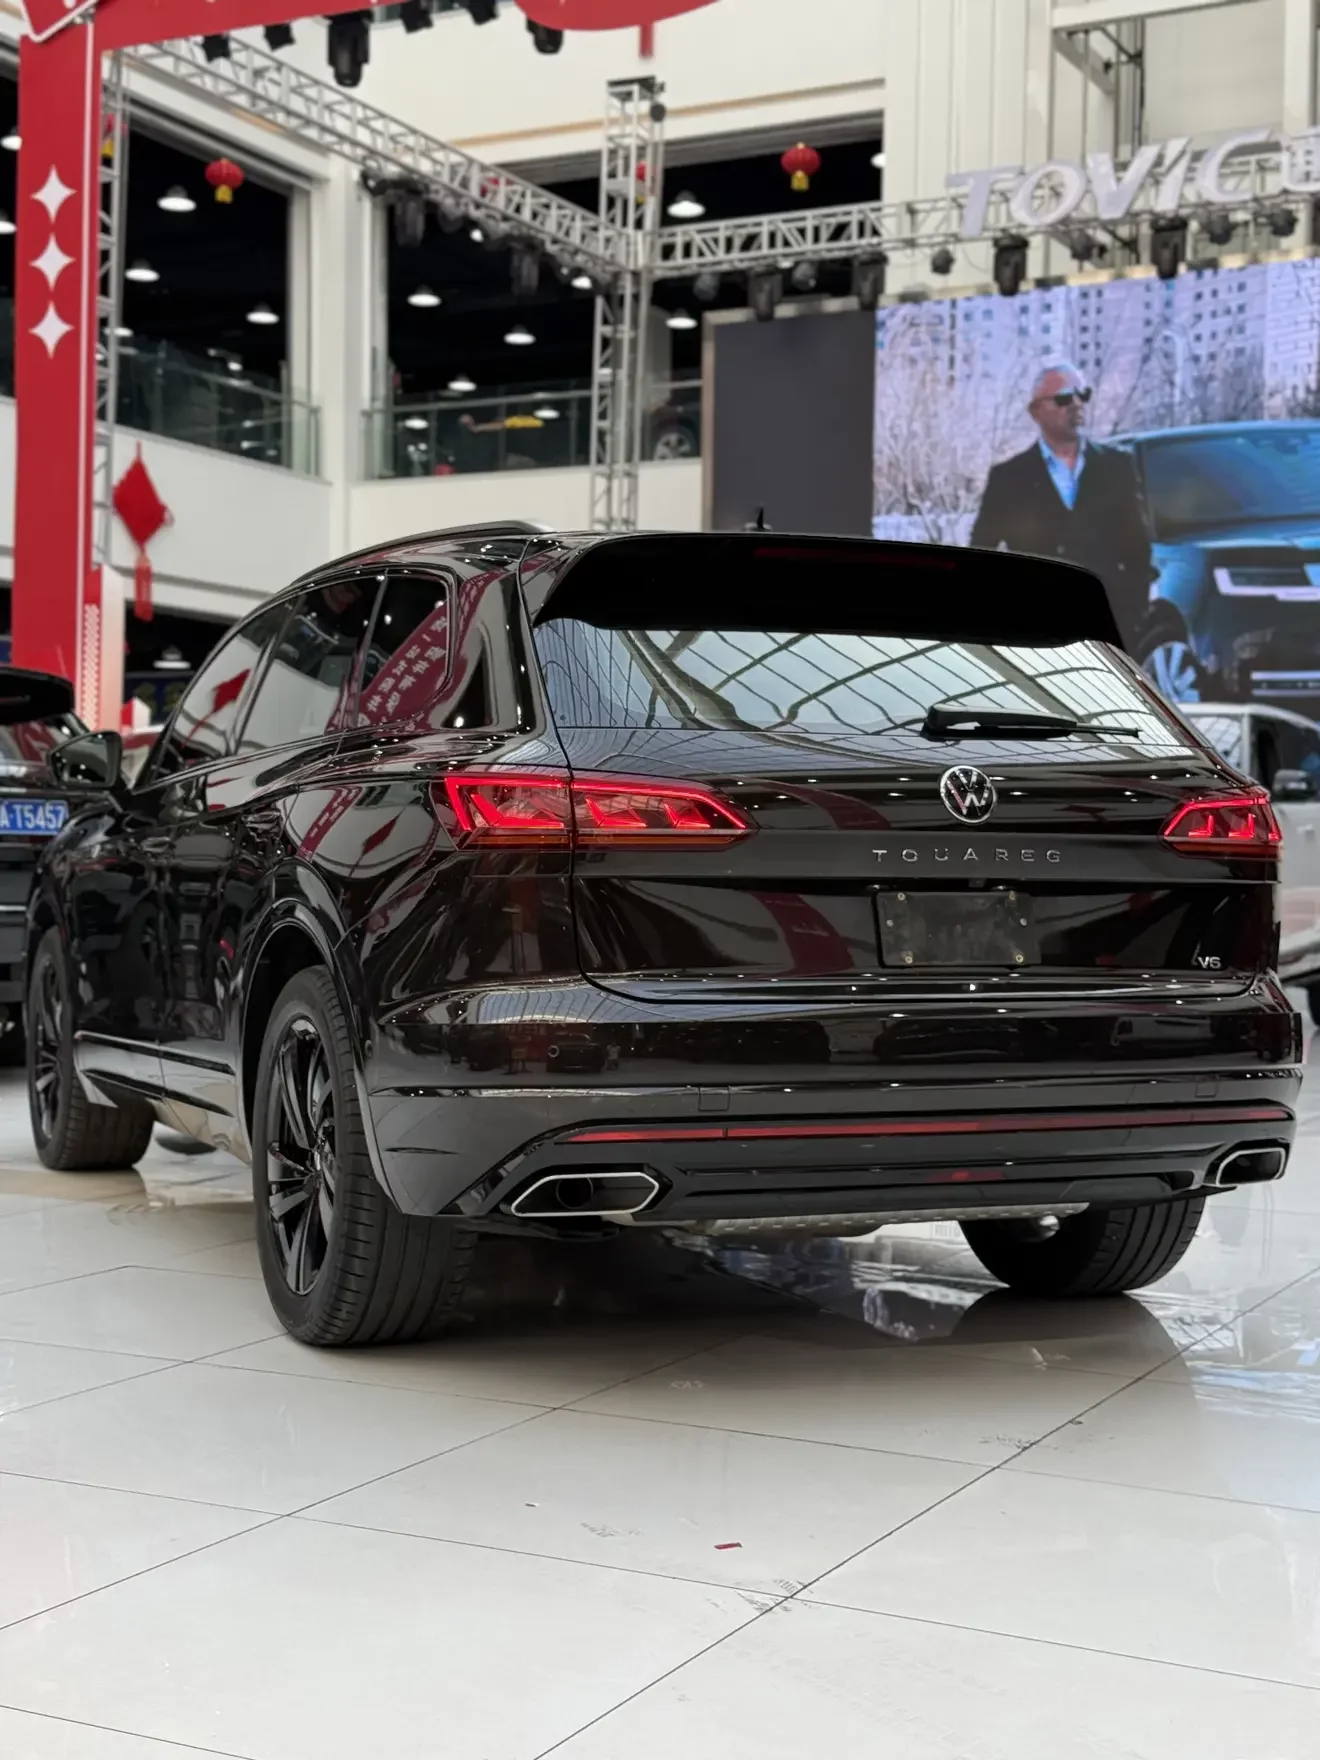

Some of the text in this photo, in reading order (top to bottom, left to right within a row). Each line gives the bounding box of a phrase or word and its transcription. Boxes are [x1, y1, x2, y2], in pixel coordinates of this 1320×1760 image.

[945, 128, 1272, 237] TOVIC
[872, 848, 1061, 863] TOUAREG
[1197, 956, 1222, 969] V6
